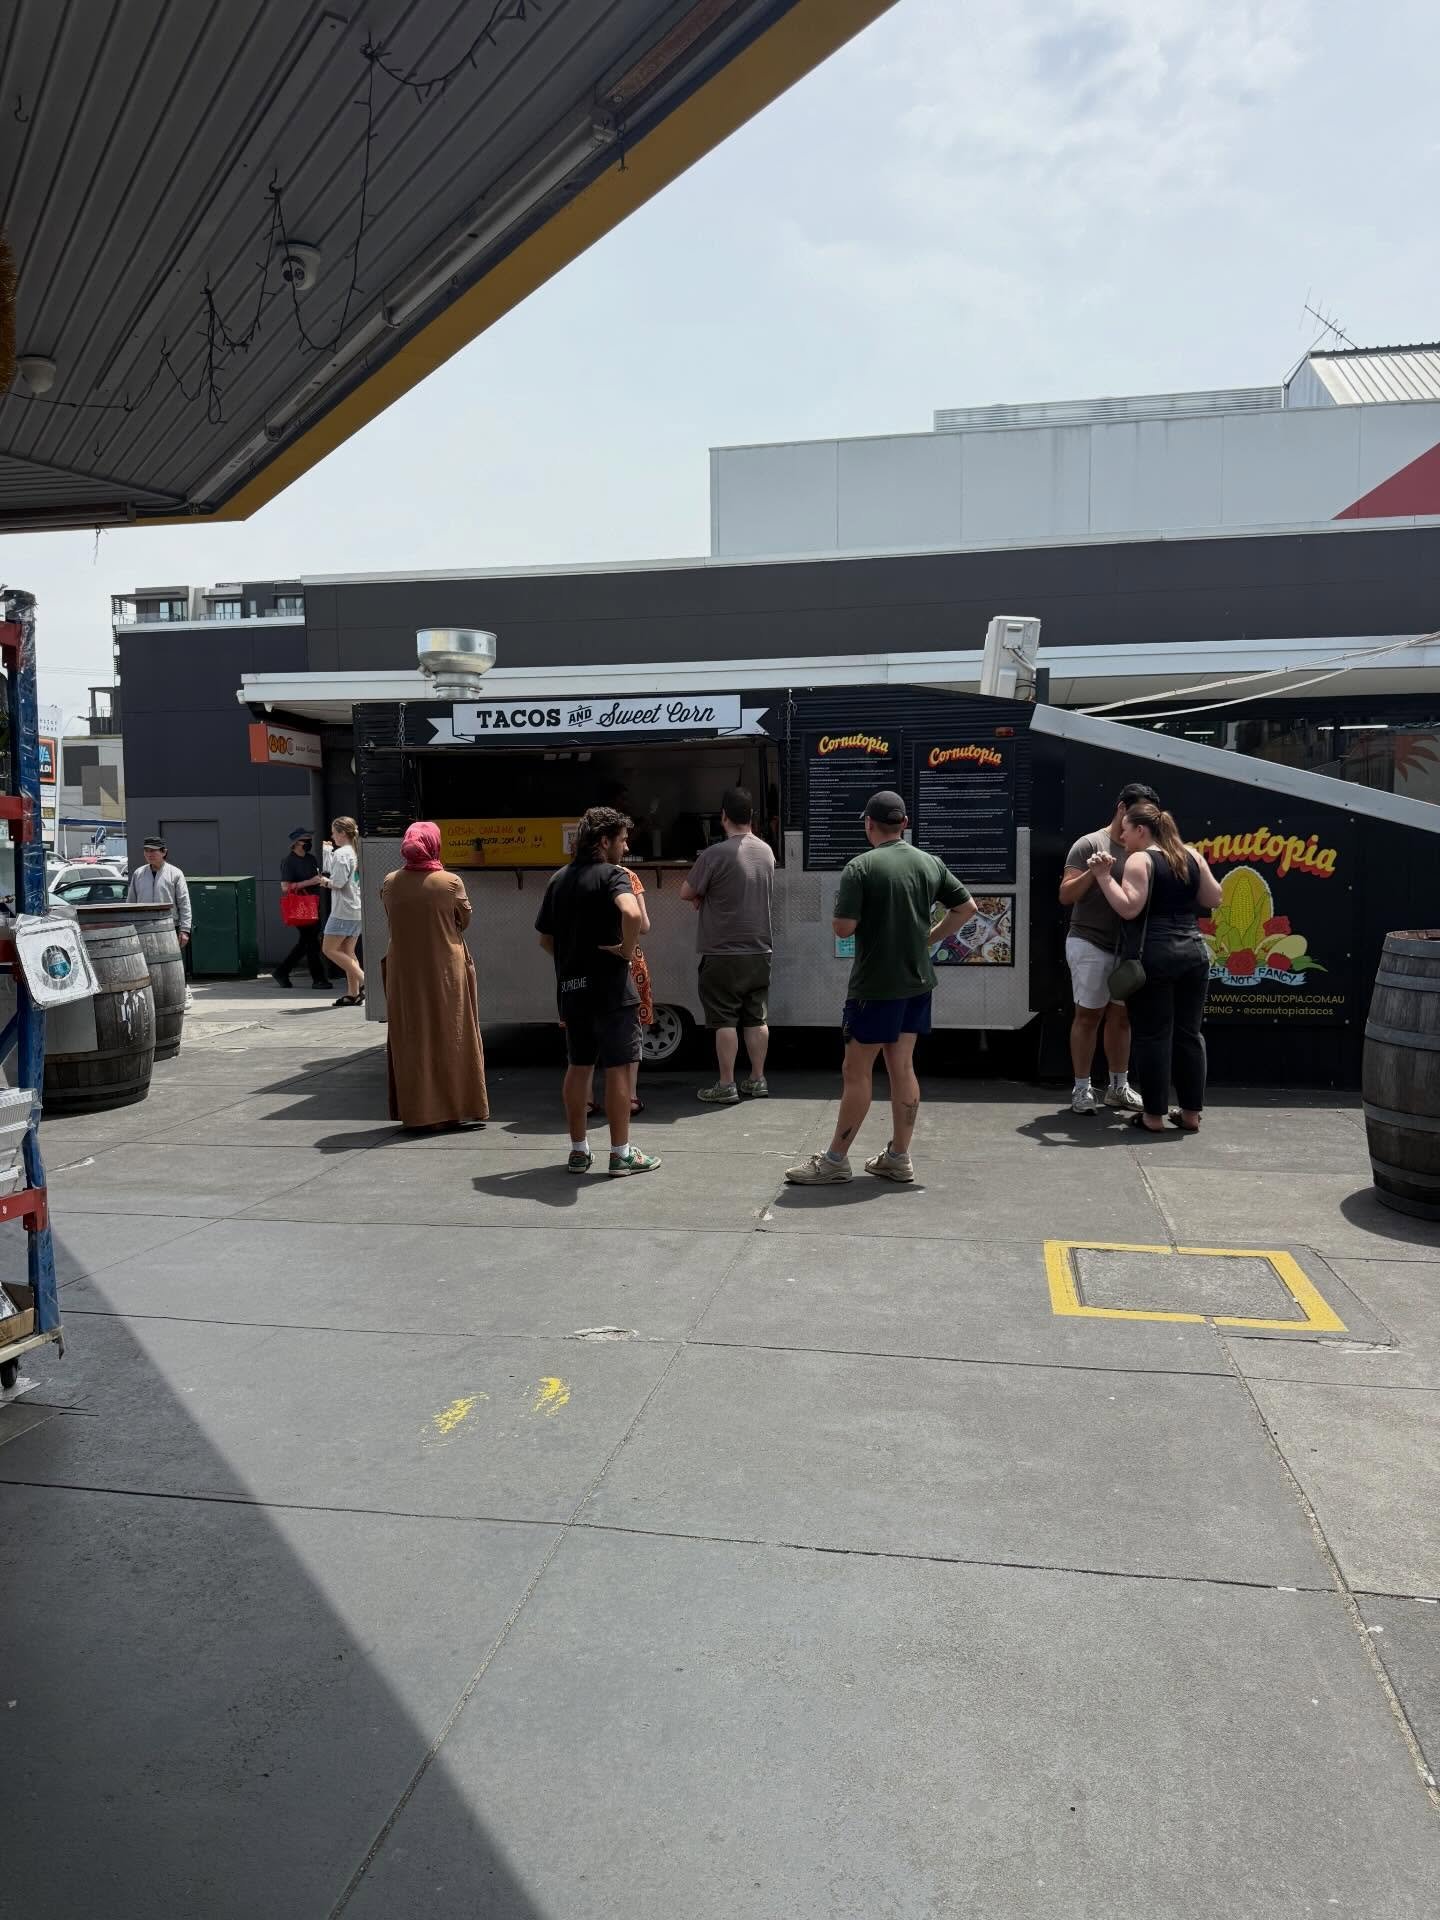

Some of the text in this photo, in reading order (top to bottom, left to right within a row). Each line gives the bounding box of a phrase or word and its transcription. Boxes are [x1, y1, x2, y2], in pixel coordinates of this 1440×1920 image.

[477, 702, 716, 729] TACOS AND Sweet Corn
[818, 733, 890, 755] Cornutopia
[929, 745, 1003, 767] Cornutopia
[40, 764, 52, 774] LDI
[1185, 827, 1338, 875] rnutopia
[1230, 975, 1252, 985] NOT
[1258, 967, 1297, 984] FANCY
[1211, 994, 1345, 1004] WWW.CORNUTOPIA.COM.AU
[1203, 1006, 1334, 1017] ERING @cornutopiatacos
